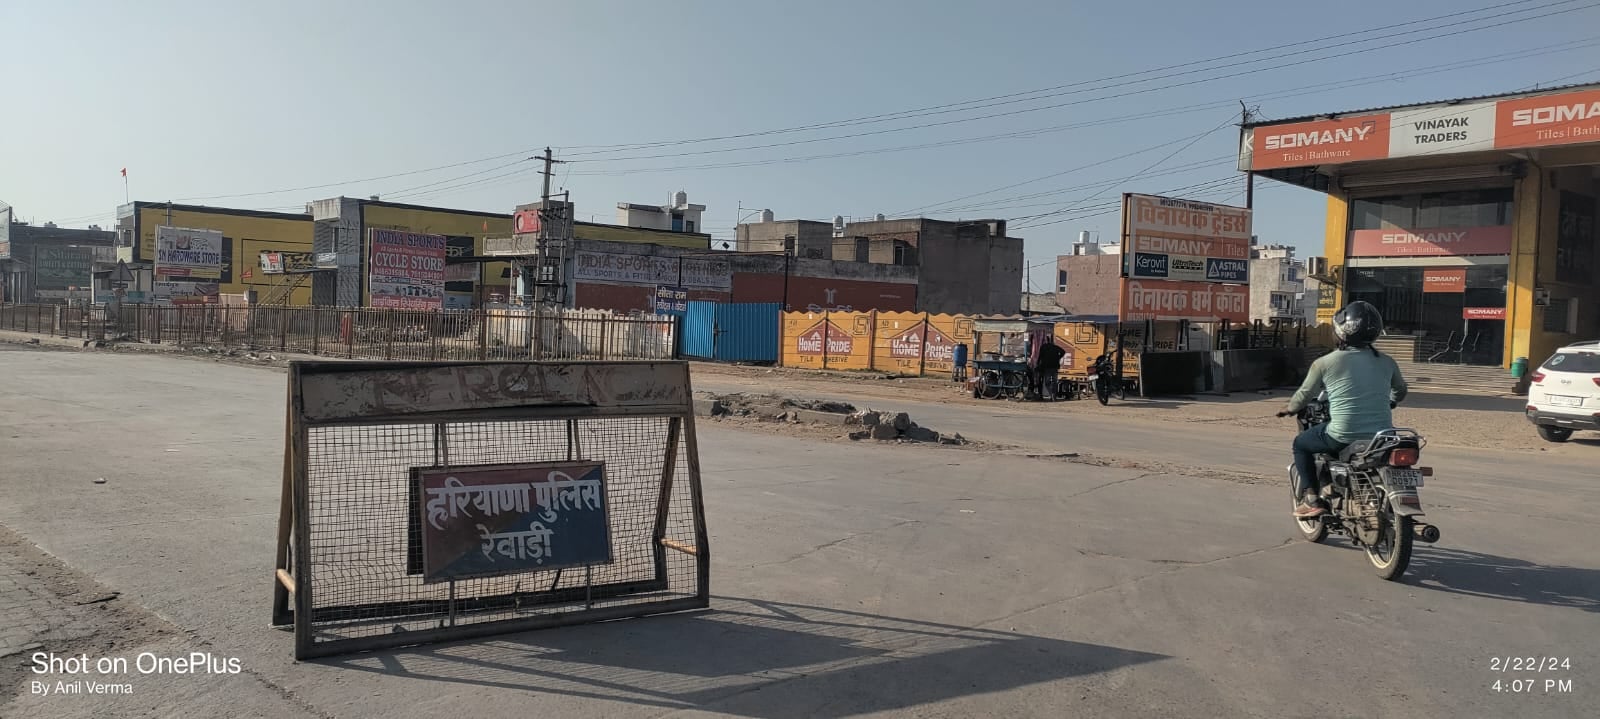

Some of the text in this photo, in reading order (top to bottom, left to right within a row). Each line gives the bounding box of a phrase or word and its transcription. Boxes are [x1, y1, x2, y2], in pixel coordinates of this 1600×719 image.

[1414, 117, 1469, 131] VINAYAK
[1265, 125, 1371, 150] SOMANY
[1414, 131, 1468, 144] TRADERS
[1536, 129, 1565, 140] Tiles
[1283, 149, 1351, 161] Tiles Bathware
[1137, 201, 1208, 229] विनायक
[376, 230, 444, 249] INDIA SPORTS
[1138, 235, 1245, 257] SOMANY Tiles
[1382, 231, 1466, 244] SOMANY
[201, 251, 220, 265] STORE
[375, 252, 408, 269] CYCLE
[411, 255, 444, 272] STORE
[1136, 256, 1165, 268] Kerovit
[1219, 261, 1246, 272] ASTRAL
[1220, 271, 1237, 279] PIPES
[1128, 281, 1188, 311] विनायक
[798, 336, 850, 353] HOME PRIDE
[892, 339, 952, 359] HOME PRIDE
[425, 470, 602, 531] हरियाणा पुलिस
[475, 520, 554, 565] रेवाड़ी
